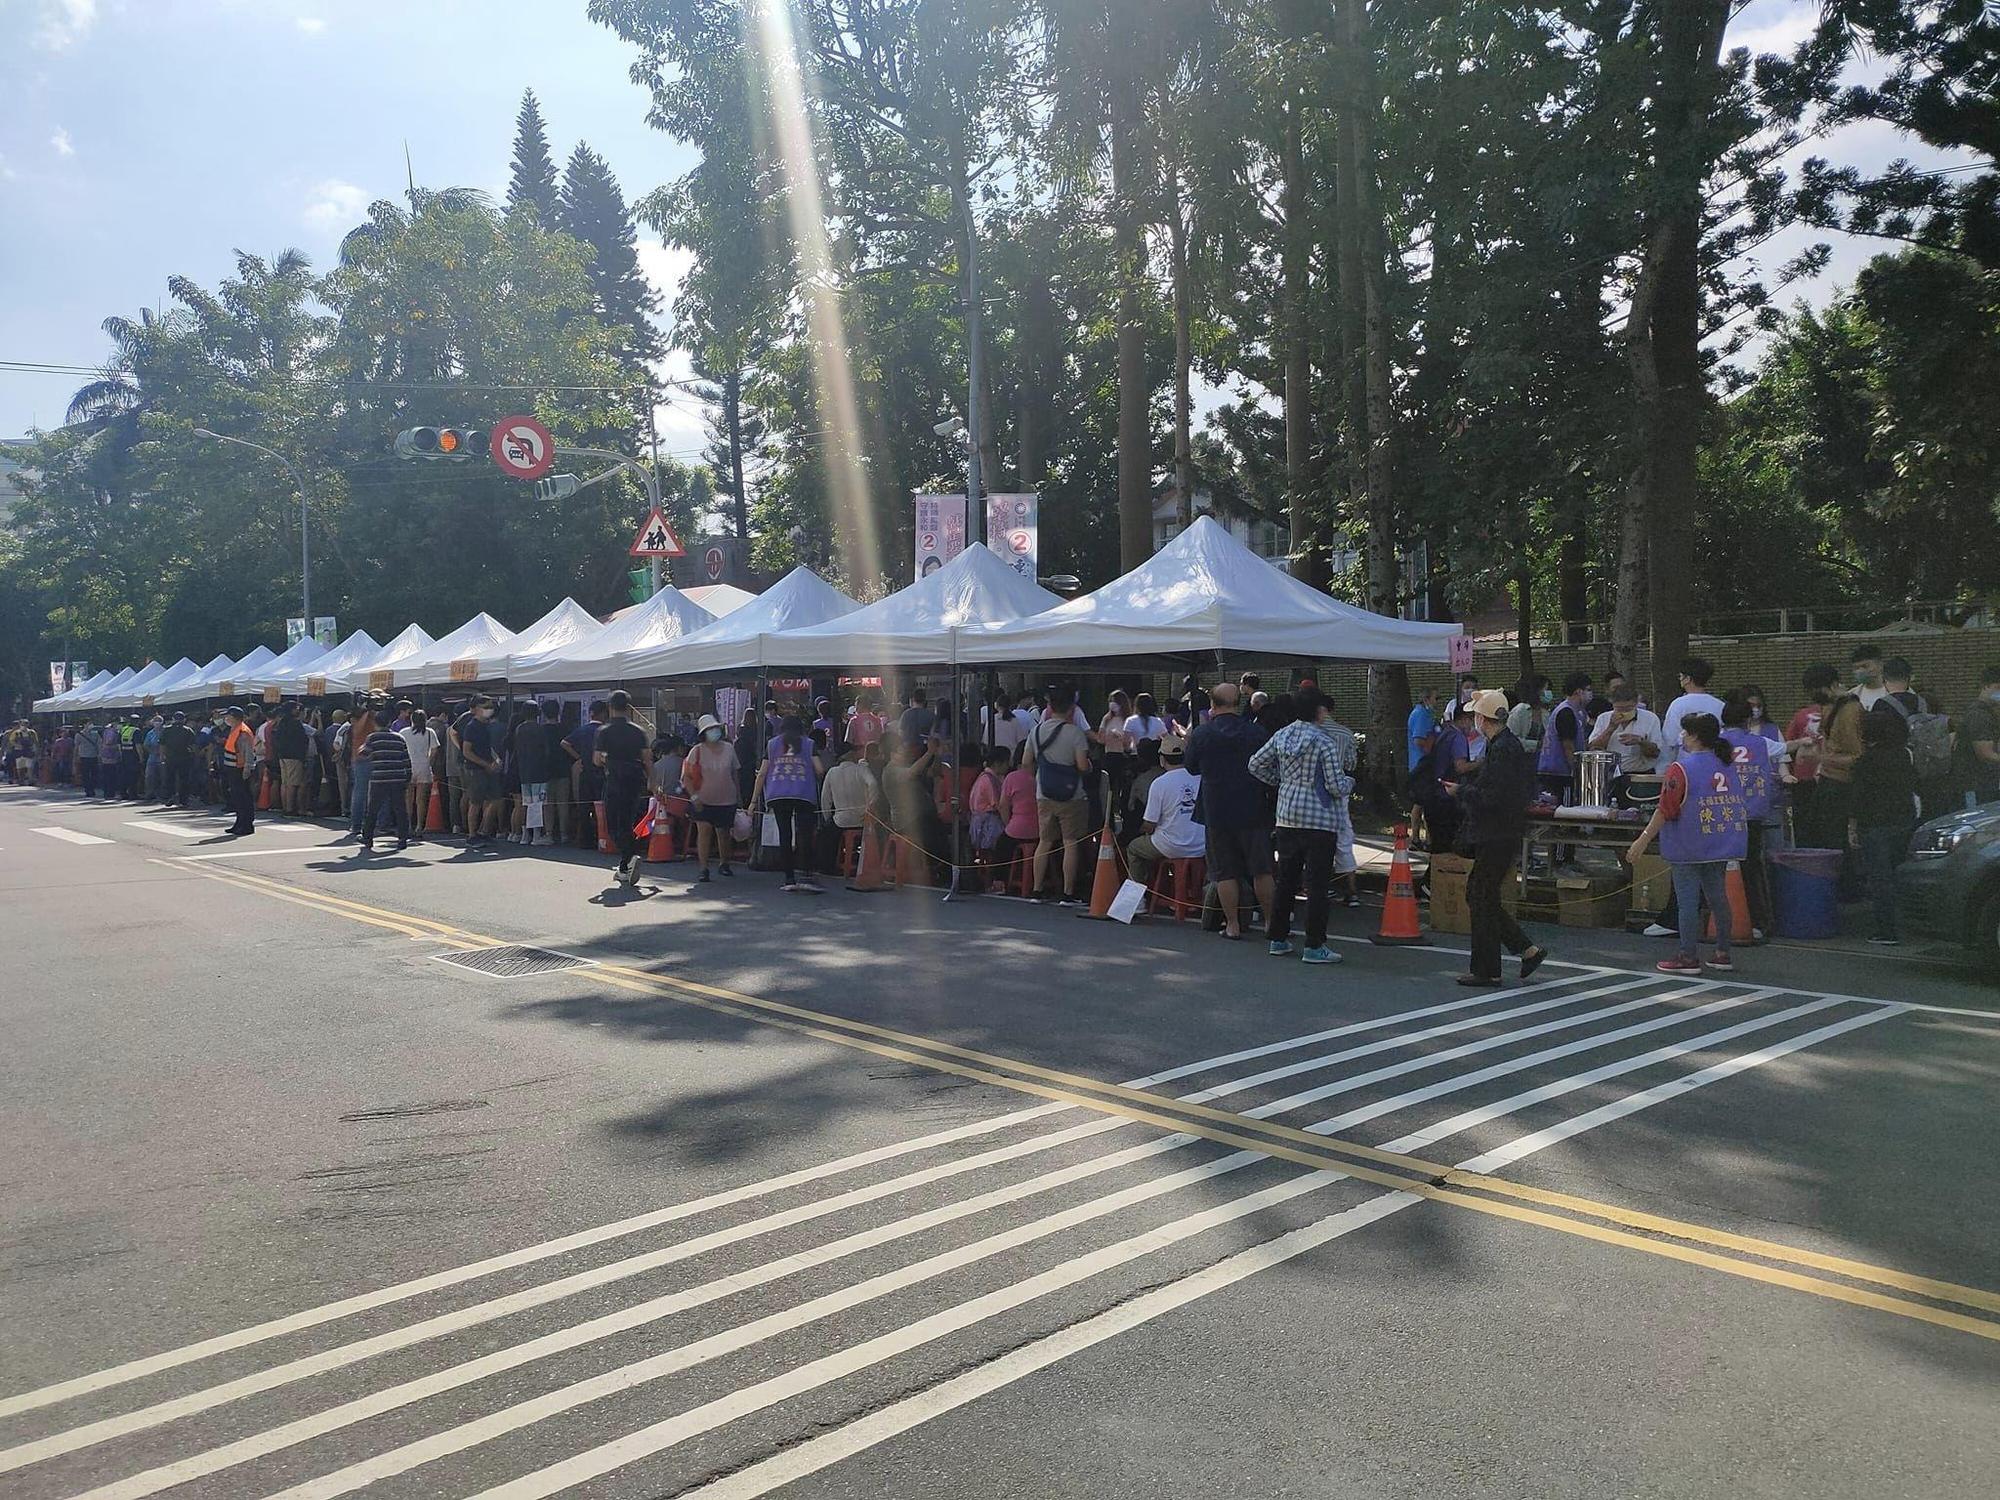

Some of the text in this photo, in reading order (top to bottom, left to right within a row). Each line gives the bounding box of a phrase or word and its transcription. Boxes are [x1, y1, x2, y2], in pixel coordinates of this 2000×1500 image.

[923, 535, 934, 548] 2
[1014, 534, 1027, 551] 2
[1733, 746, 1749, 763] 2
[1714, 772, 1729, 792] 2
